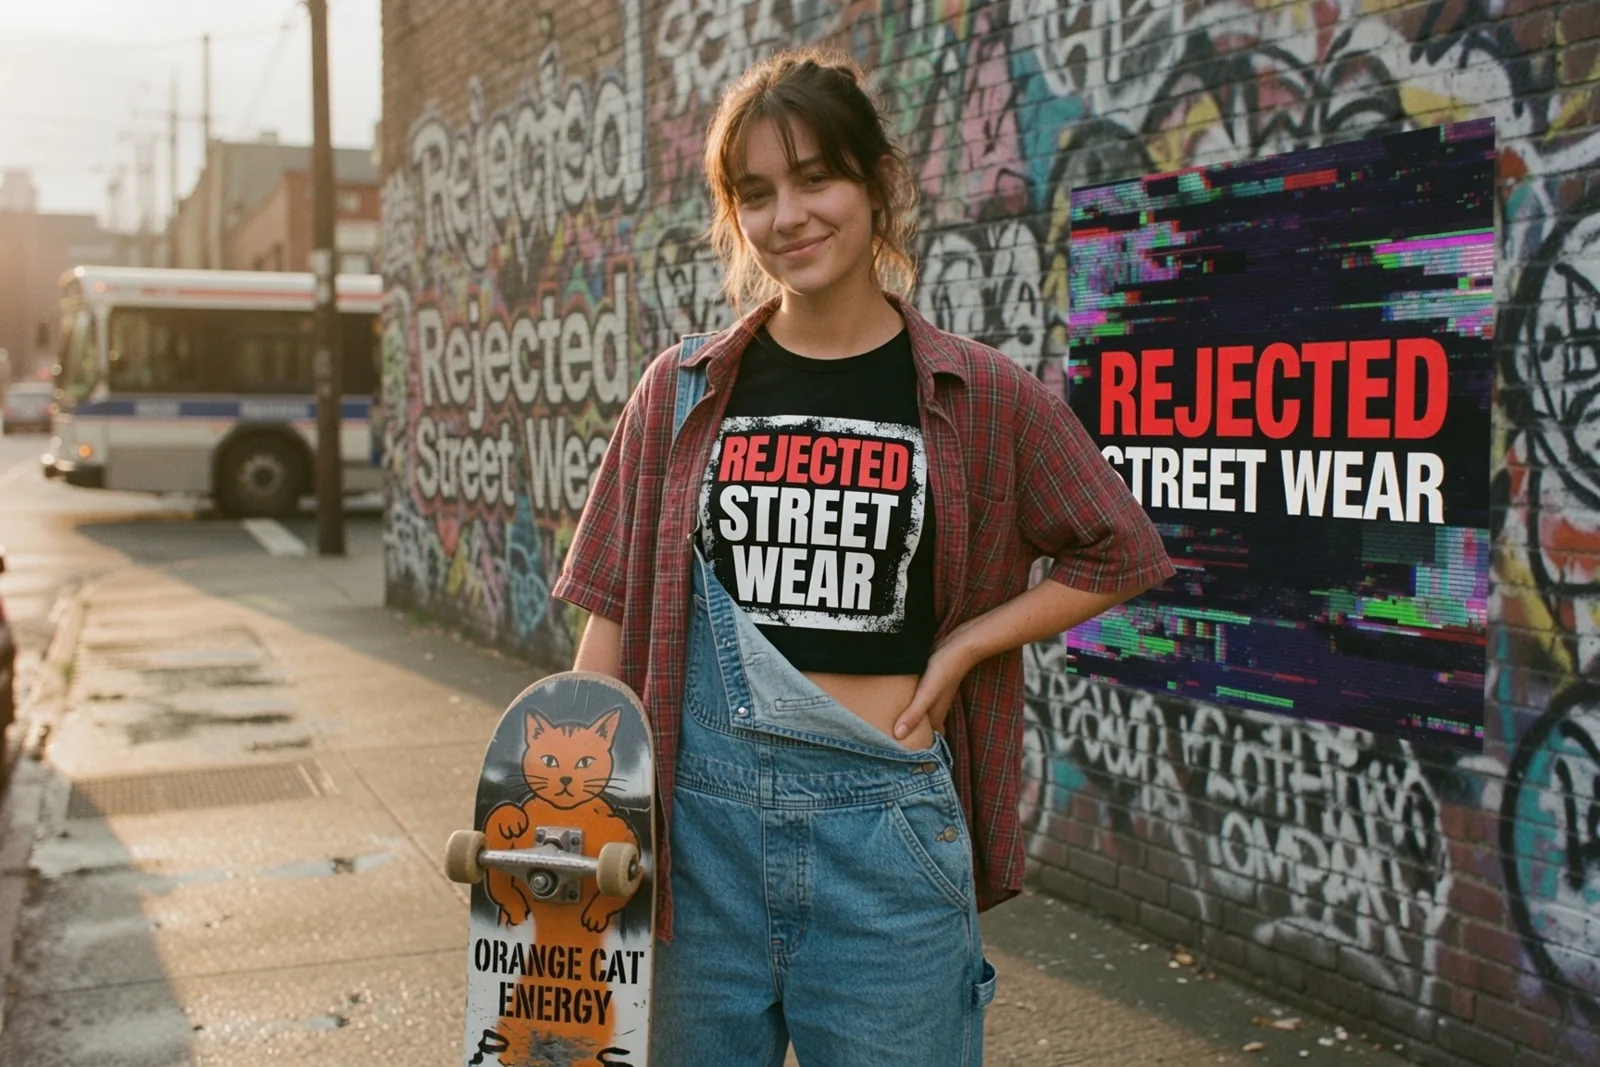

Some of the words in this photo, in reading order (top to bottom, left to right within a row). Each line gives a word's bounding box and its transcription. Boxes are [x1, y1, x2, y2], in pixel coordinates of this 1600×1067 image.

[417, 272, 629, 429] Rejected
[1100, 337, 1449, 439] REJECTED
[417, 416, 515, 505] Street
[718, 435, 910, 491] REJECTED
[1280, 450, 1445, 524] WEAR
[719, 485, 900, 551] STREET
[732, 545, 876, 611] WEAR
[474, 938, 582, 981] ORANGE
[590, 948, 645, 984] CAT
[499, 981, 613, 1025] ENERGY
